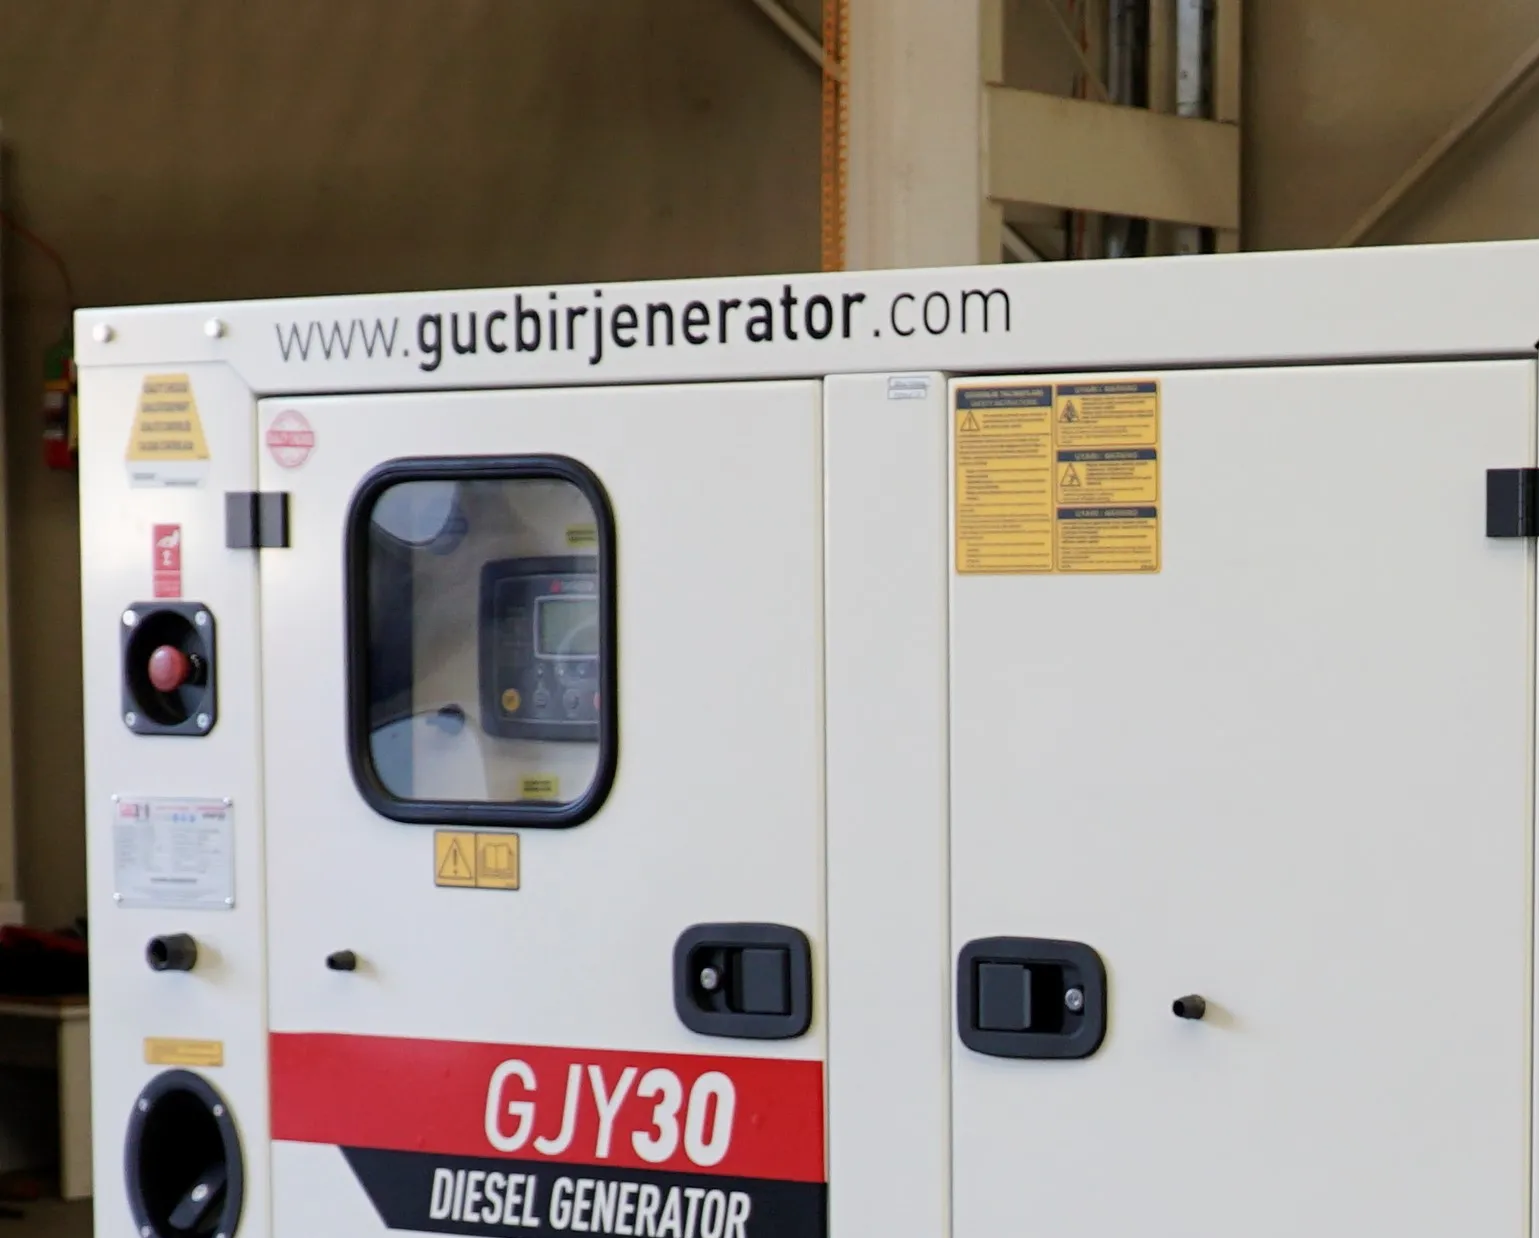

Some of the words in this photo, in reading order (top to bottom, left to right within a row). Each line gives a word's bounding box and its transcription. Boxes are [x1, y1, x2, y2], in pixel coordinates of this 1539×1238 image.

[274, 284, 1012, 372] www.gucbirjenerator.com
[484, 1058, 736, 1168] GJY30
[429, 1167, 540, 1228] DIESEL
